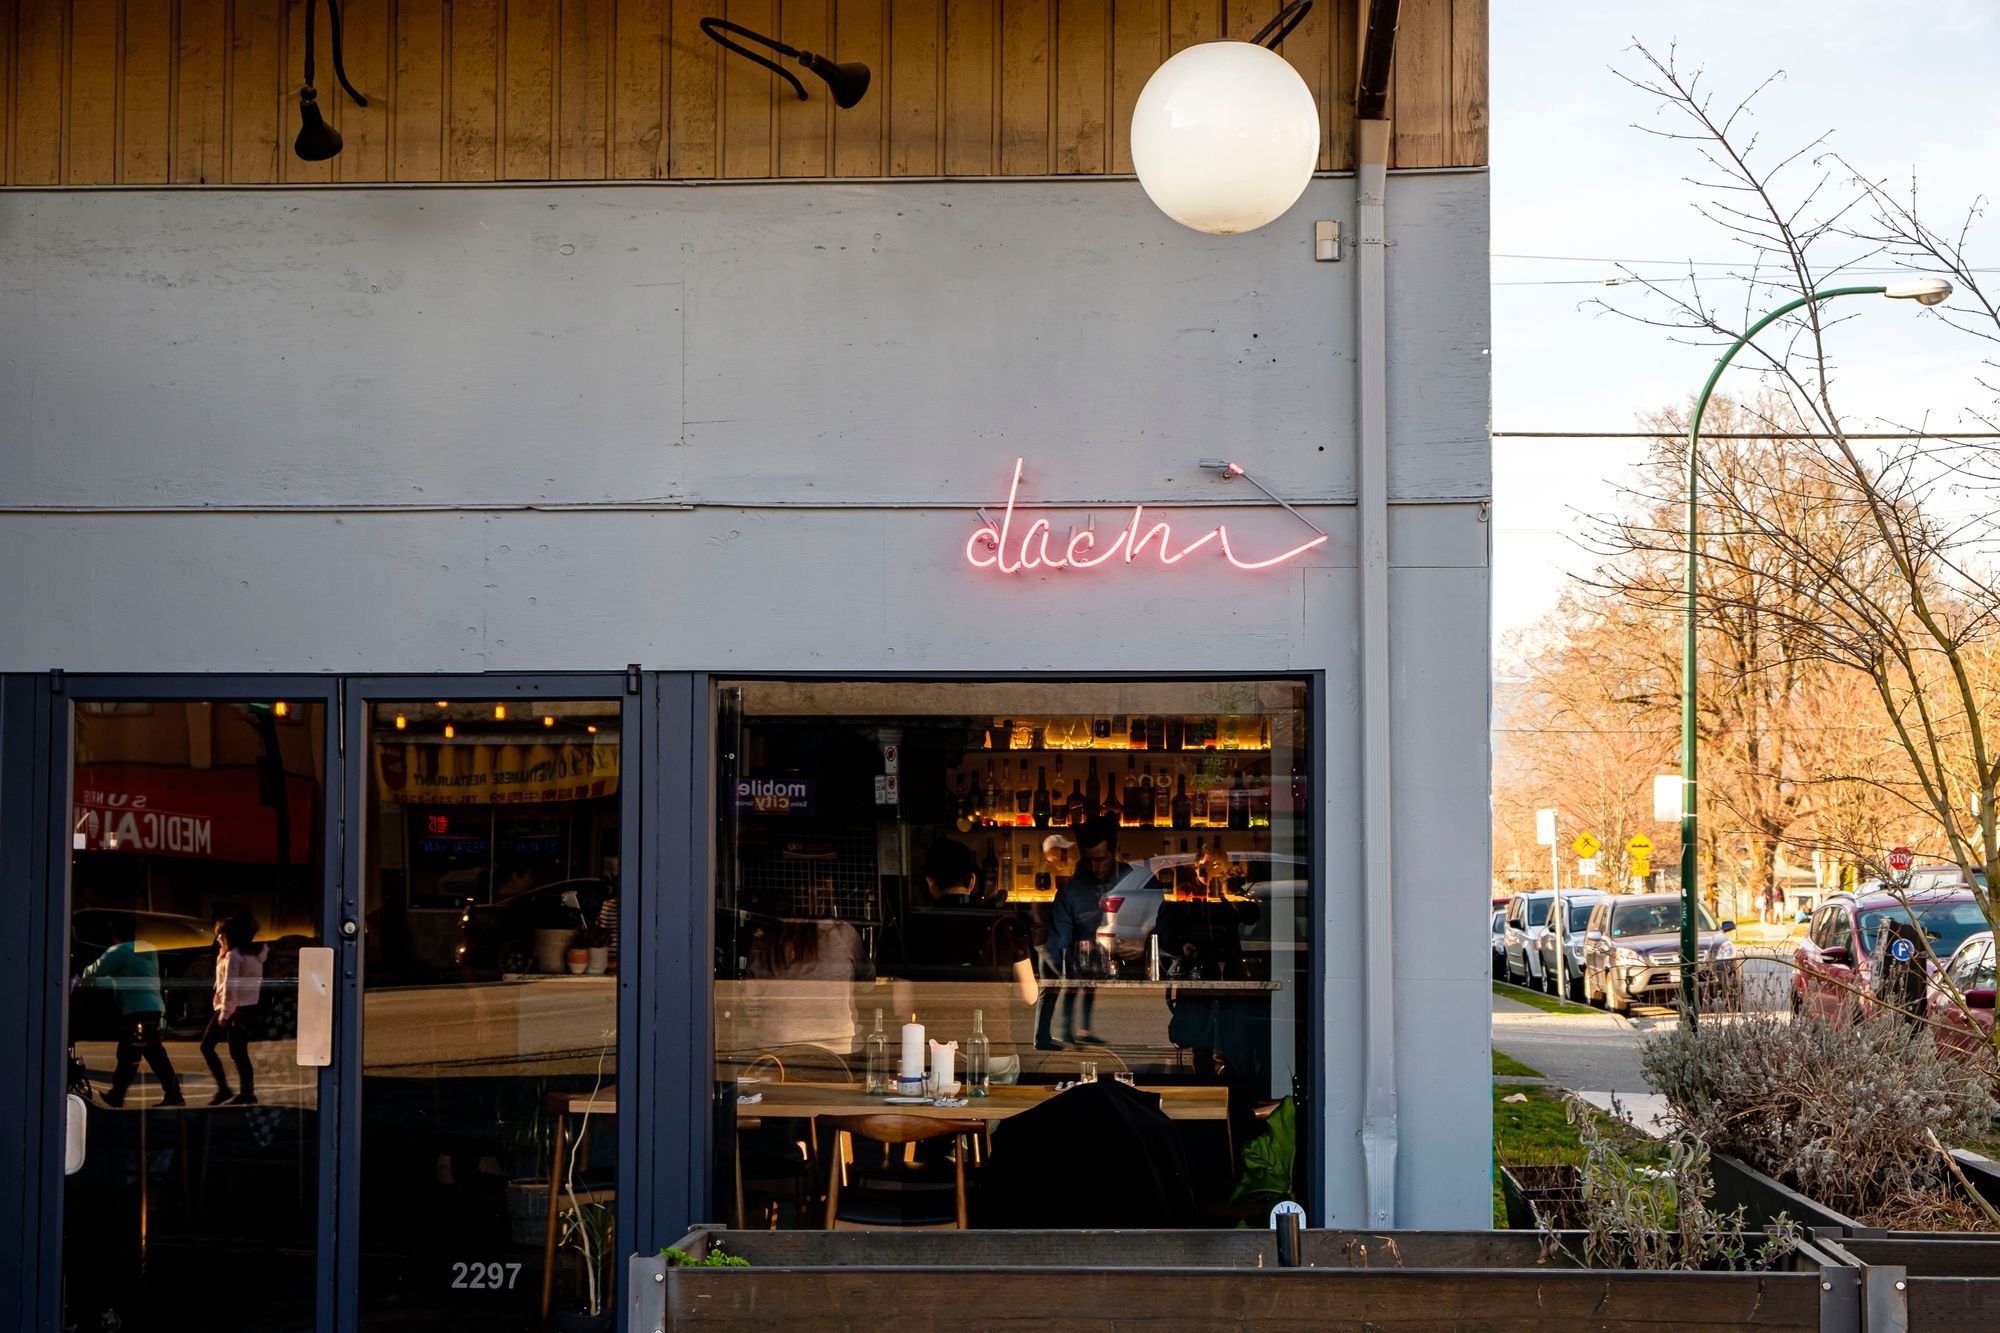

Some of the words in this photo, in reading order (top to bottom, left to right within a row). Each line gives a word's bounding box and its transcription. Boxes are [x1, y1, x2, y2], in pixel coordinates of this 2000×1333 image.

[964, 456, 1328, 574] dachi
[1636, 862, 1647, 871] 30
[451, 1262, 522, 1289] 2297
